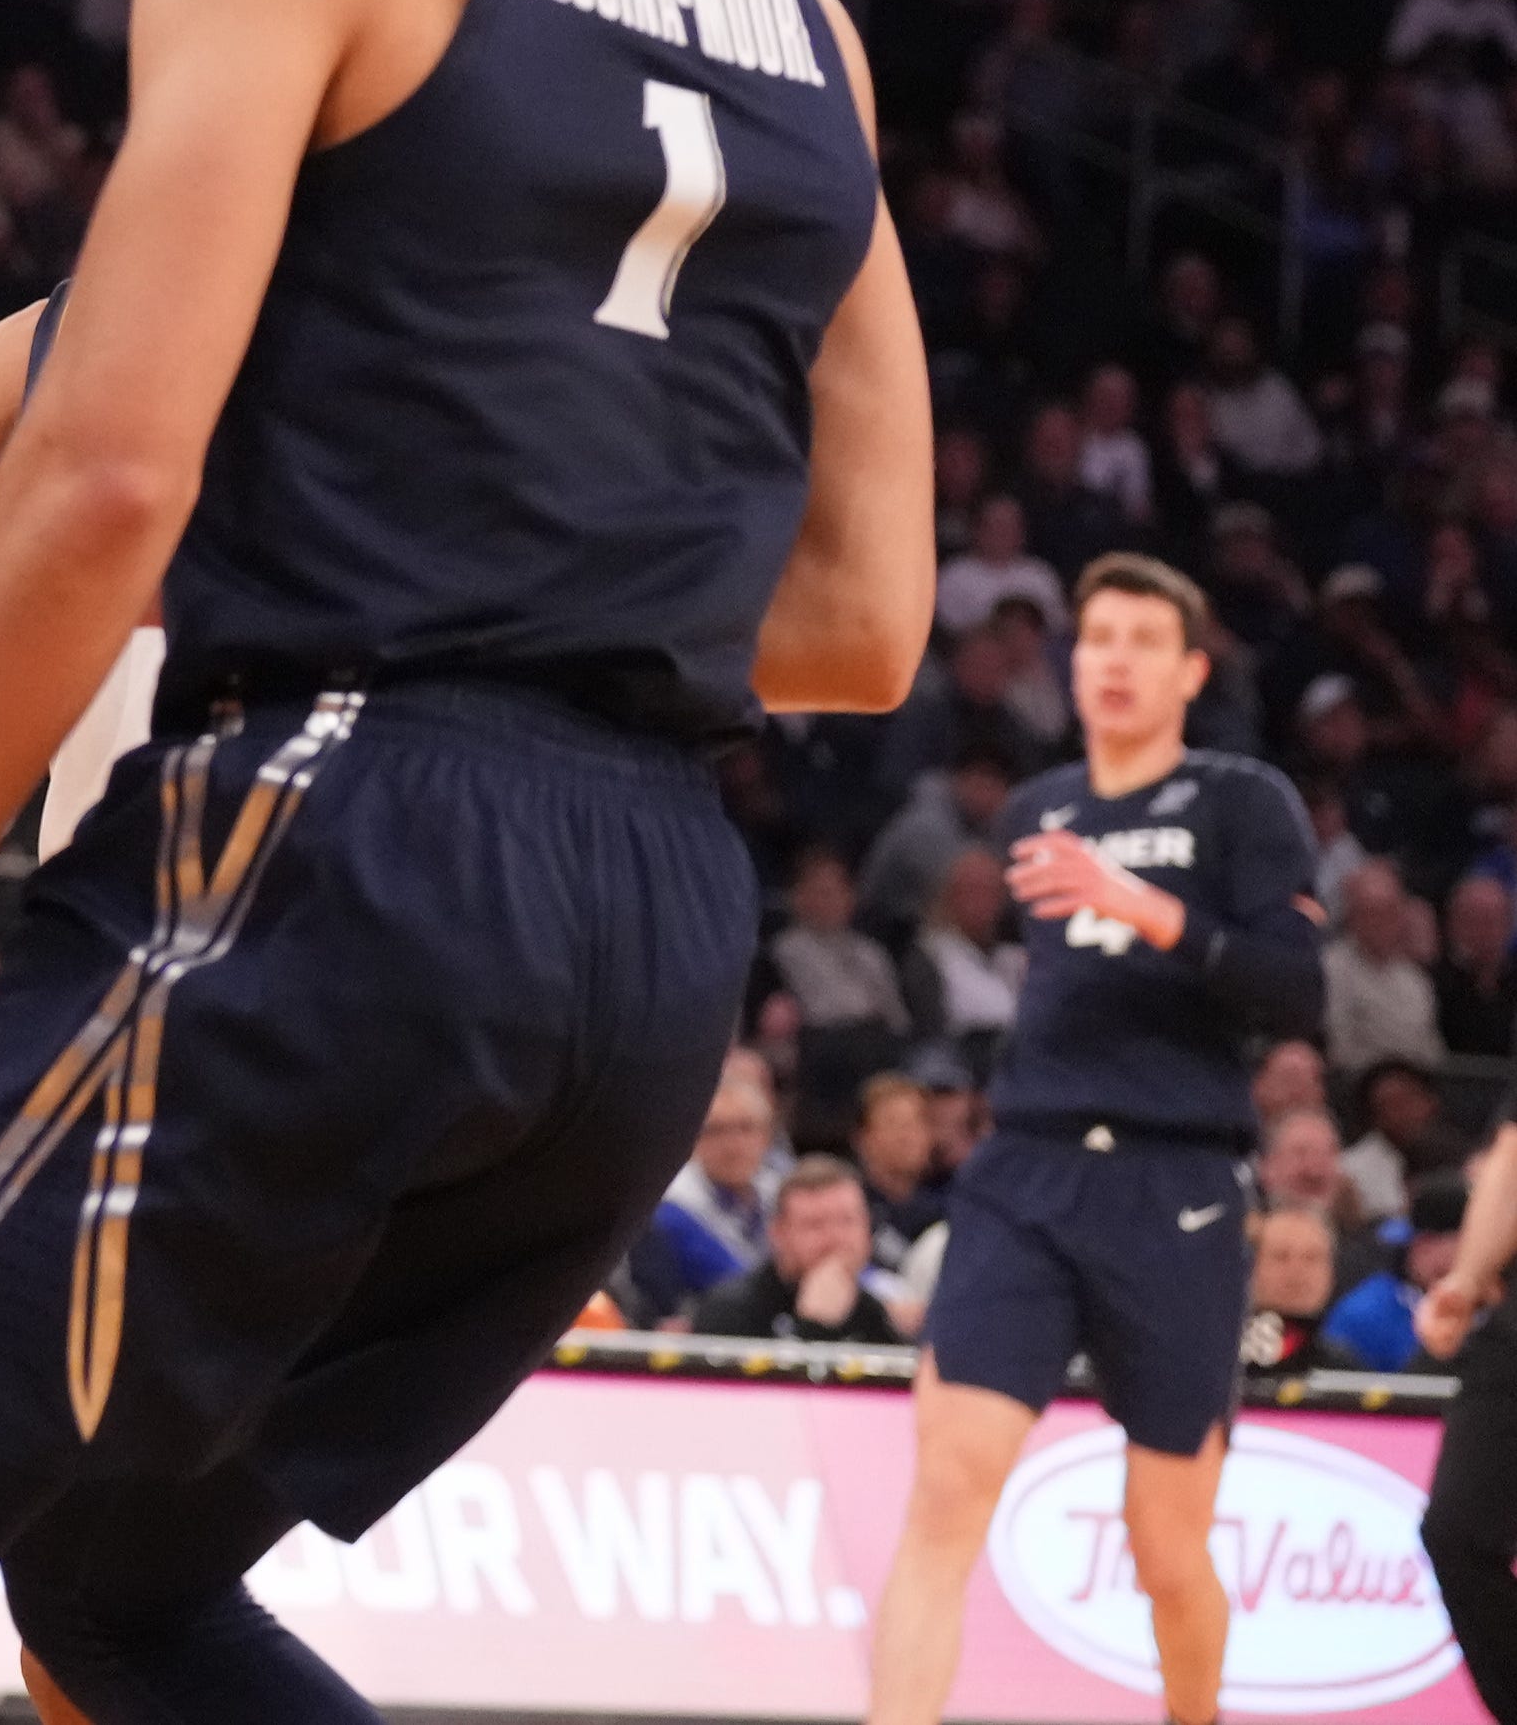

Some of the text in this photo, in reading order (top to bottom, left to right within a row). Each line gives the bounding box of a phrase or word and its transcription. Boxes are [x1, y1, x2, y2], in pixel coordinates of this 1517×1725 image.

[593, 78, 727, 340] 1
[527, 1467, 867, 1629] WAY.
[1214, 1517, 1428, 1614] Value
